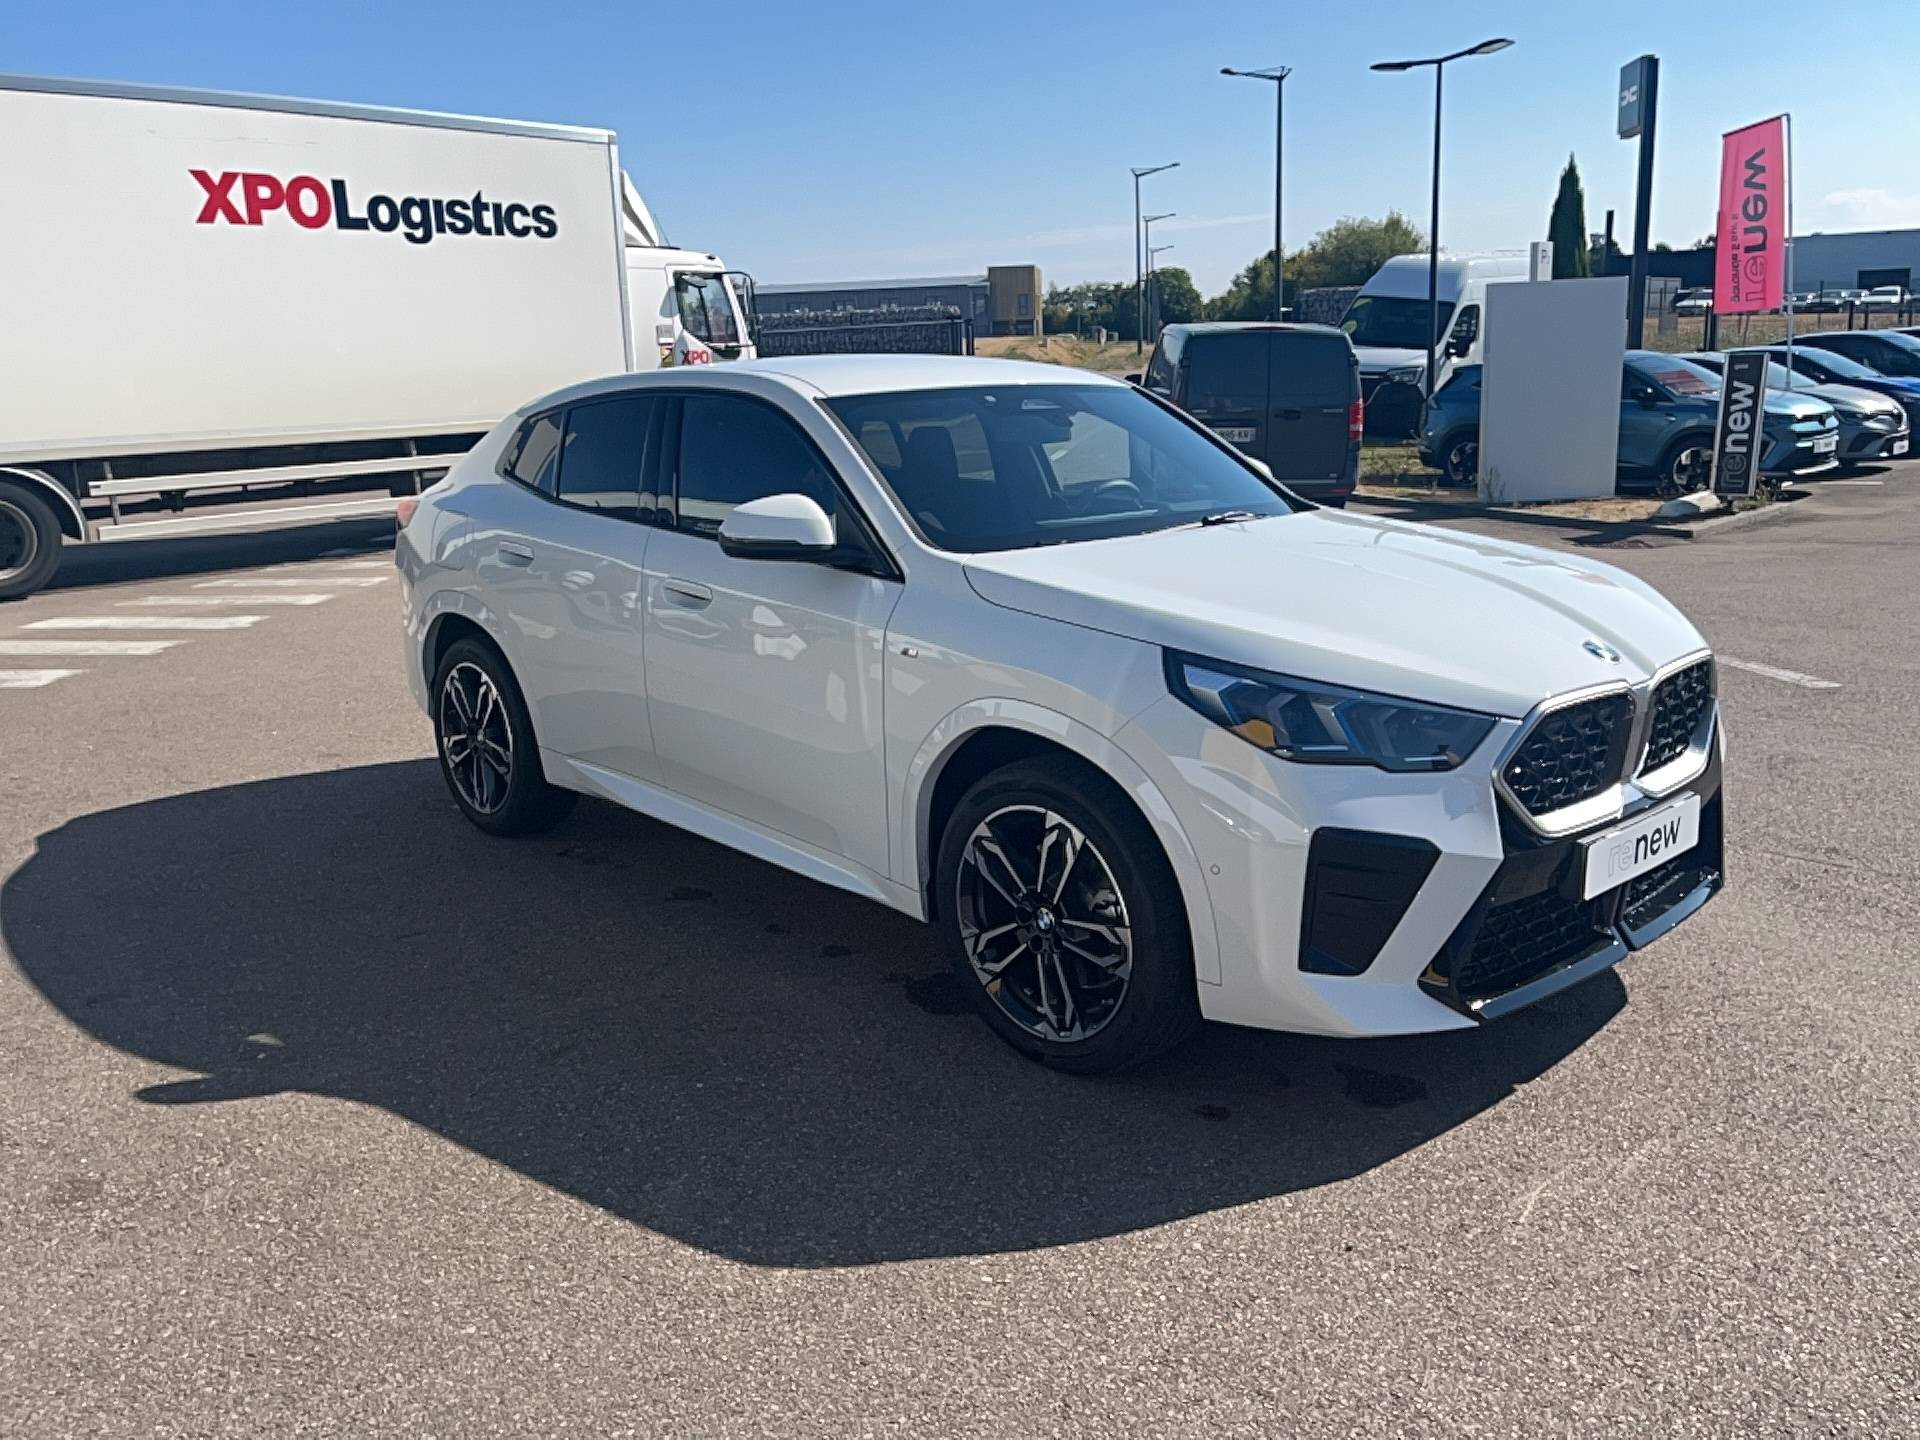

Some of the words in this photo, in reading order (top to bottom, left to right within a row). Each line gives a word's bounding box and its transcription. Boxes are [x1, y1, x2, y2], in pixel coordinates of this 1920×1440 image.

[681, 349, 709, 365] XPO
[1721, 381, 1755, 488] renew
[1608, 816, 1681, 878] renew
